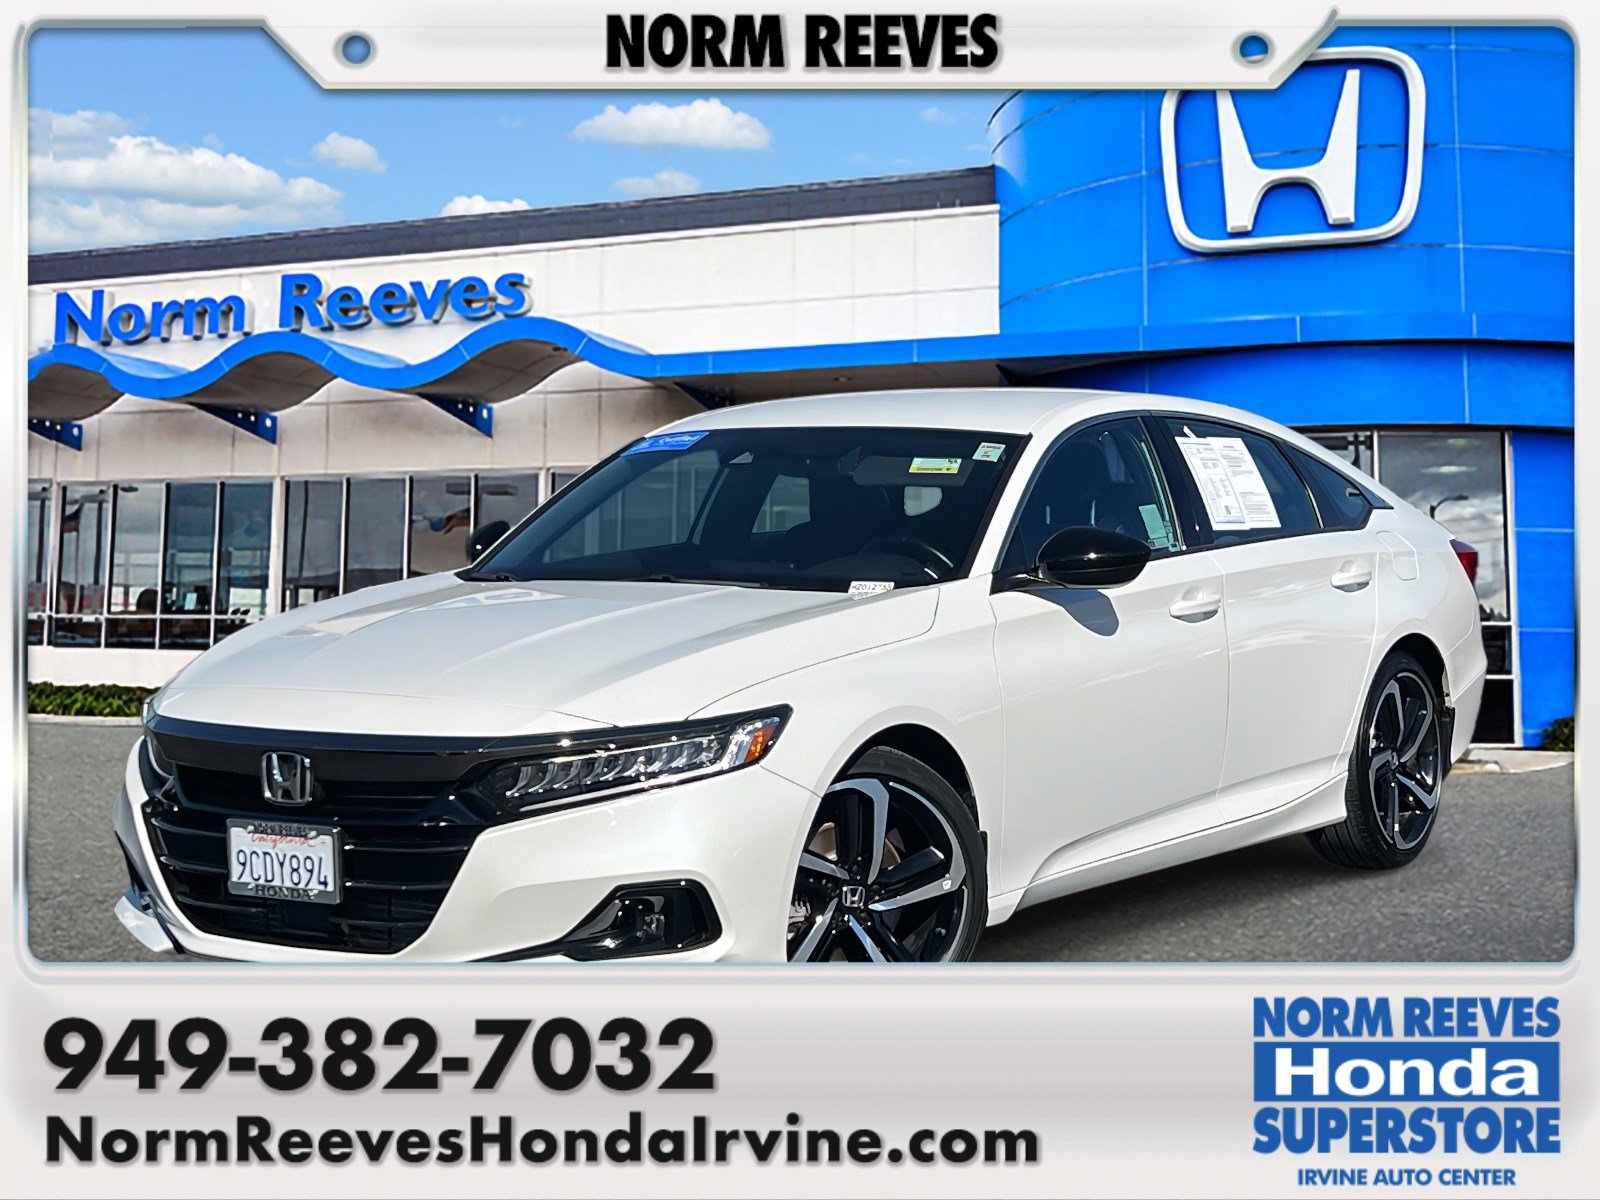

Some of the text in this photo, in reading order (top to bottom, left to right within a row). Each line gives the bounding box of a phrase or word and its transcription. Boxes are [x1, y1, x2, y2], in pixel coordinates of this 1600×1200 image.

[54, 272, 531, 345] Norm Reeves
[236, 849, 329, 889] 9CDY894
[254, 886, 313, 900] HONDA
